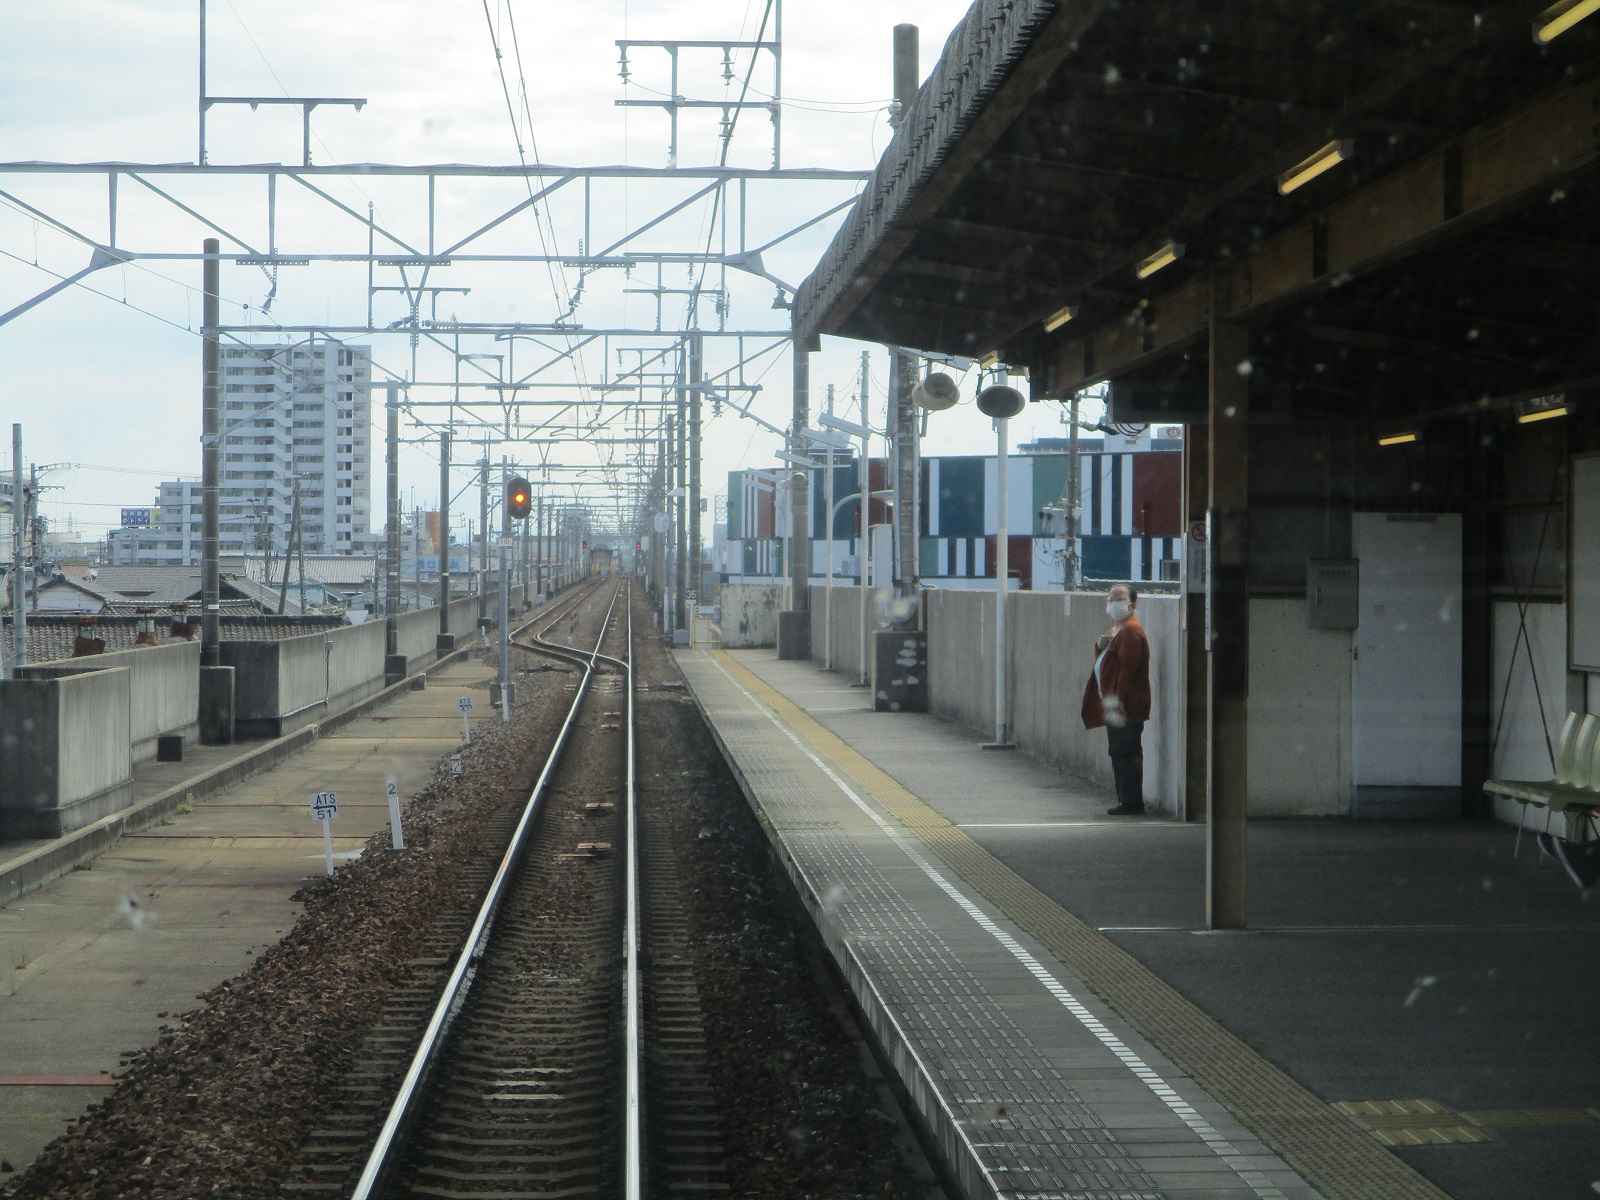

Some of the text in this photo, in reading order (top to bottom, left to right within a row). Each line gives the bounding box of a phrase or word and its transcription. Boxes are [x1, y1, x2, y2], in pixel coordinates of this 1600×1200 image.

[686, 589, 697, 599] 35
[459, 697, 471, 705] ATS
[452, 761, 460, 772] 2
[387, 783, 397, 795] 2
[316, 793, 336, 805] ATS
[317, 809, 332, 820] 51
